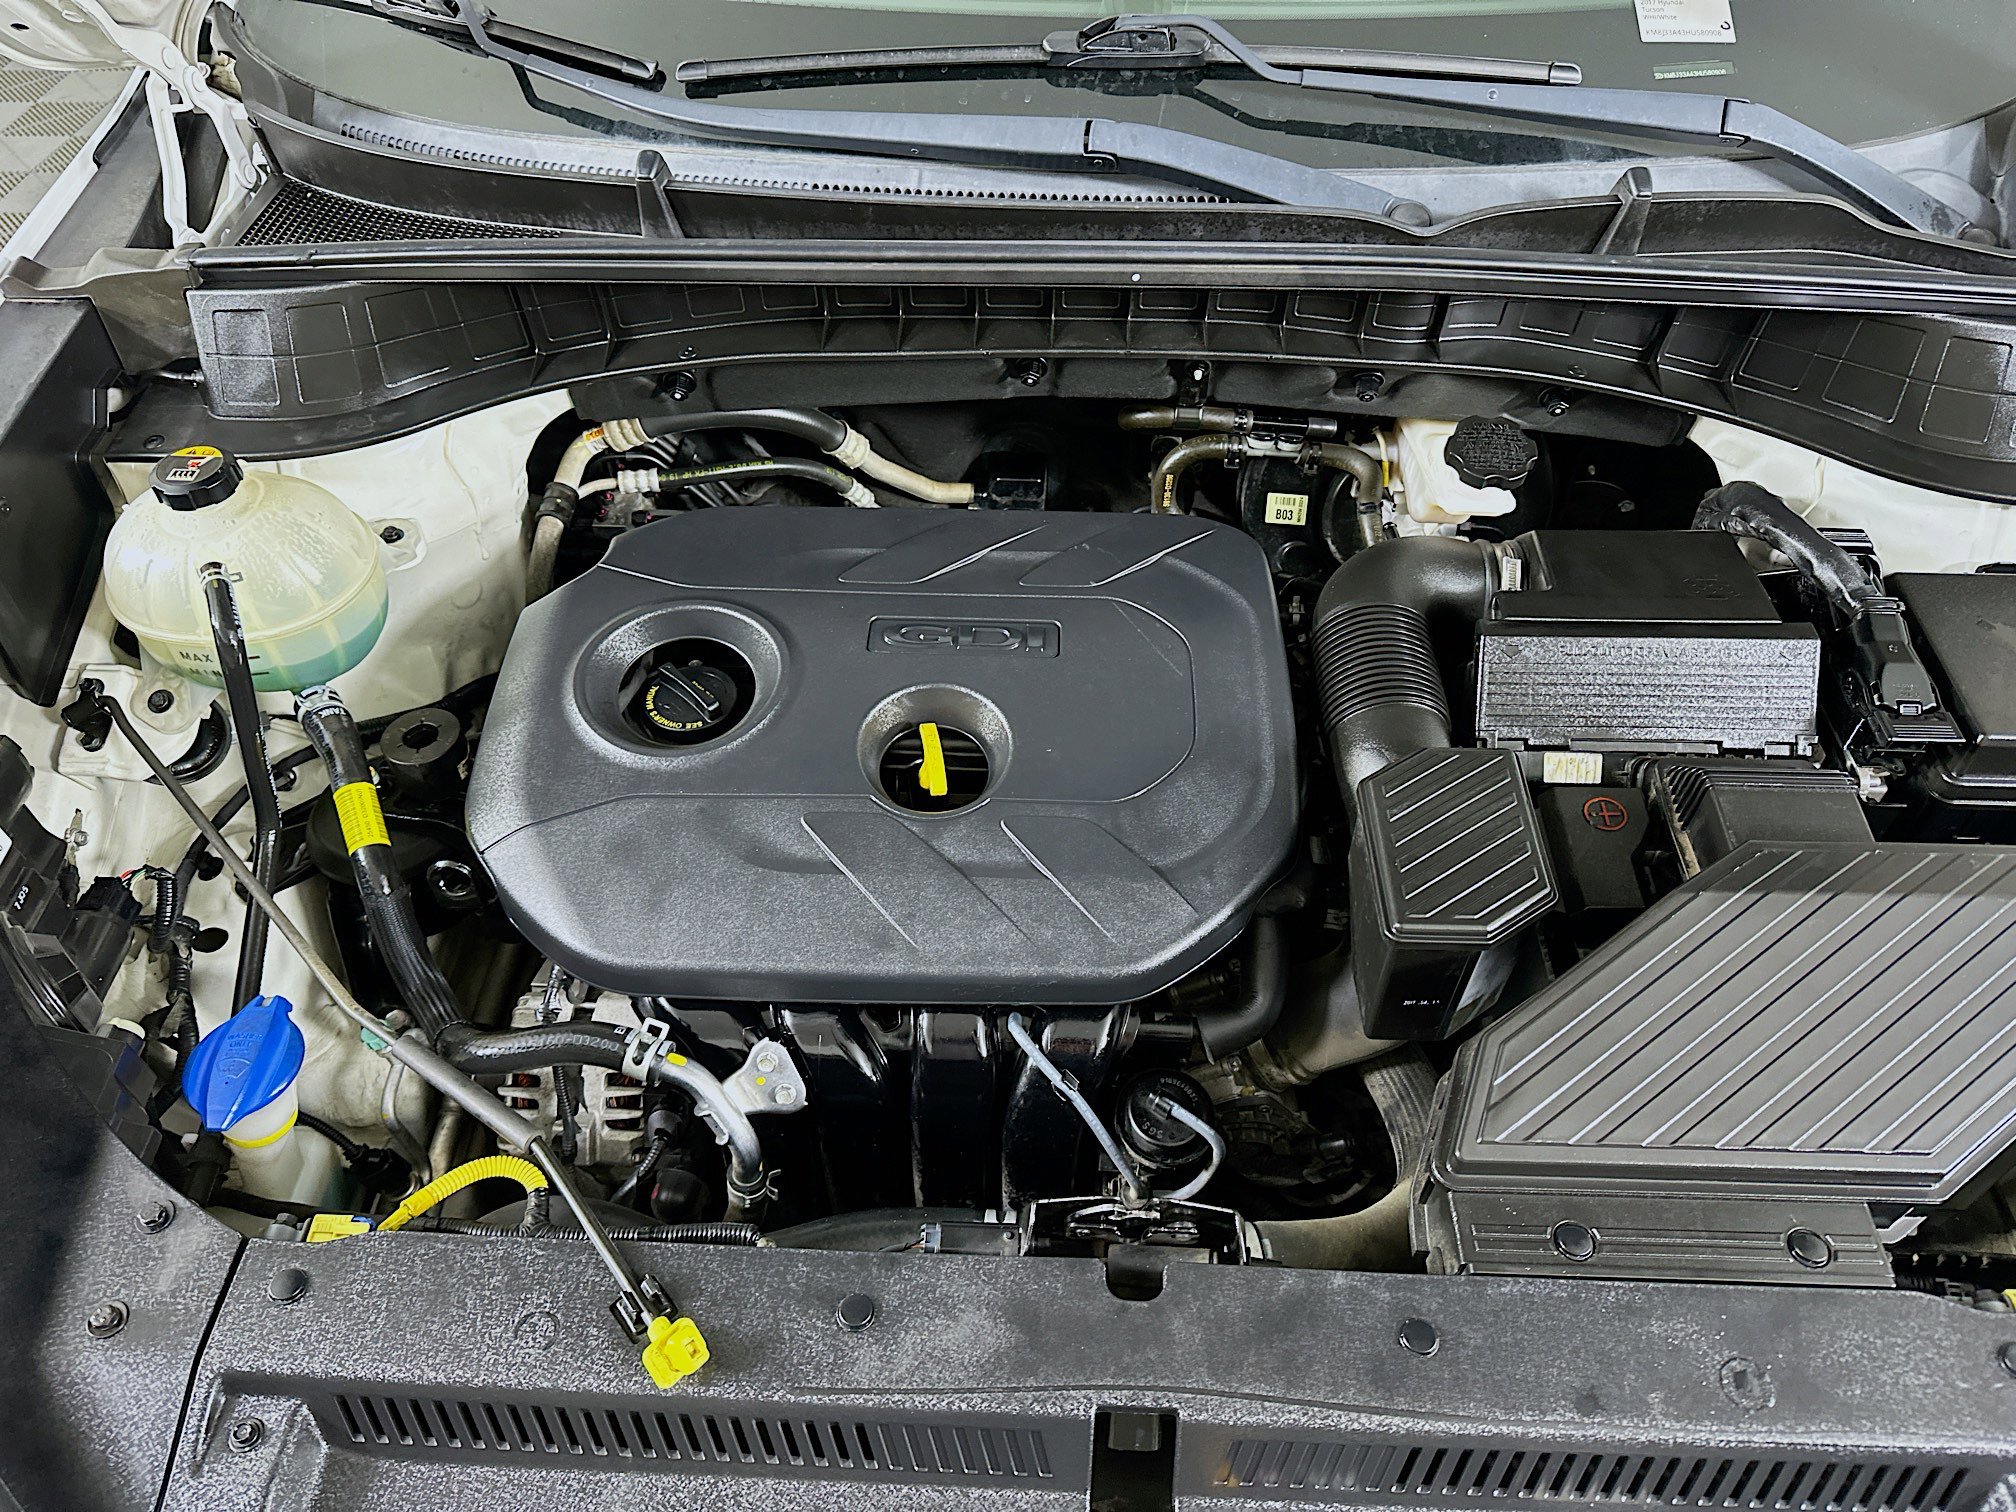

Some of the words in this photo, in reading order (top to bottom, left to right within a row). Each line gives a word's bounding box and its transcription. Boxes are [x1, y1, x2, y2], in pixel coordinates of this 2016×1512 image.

[882, 623, 1046, 652] GDI
[179, 651, 213, 663] MAX
[645, 685, 660, 710] MANUAL
[318, 706, 347, 719] TANK
[685, 720, 703, 729] SEE
